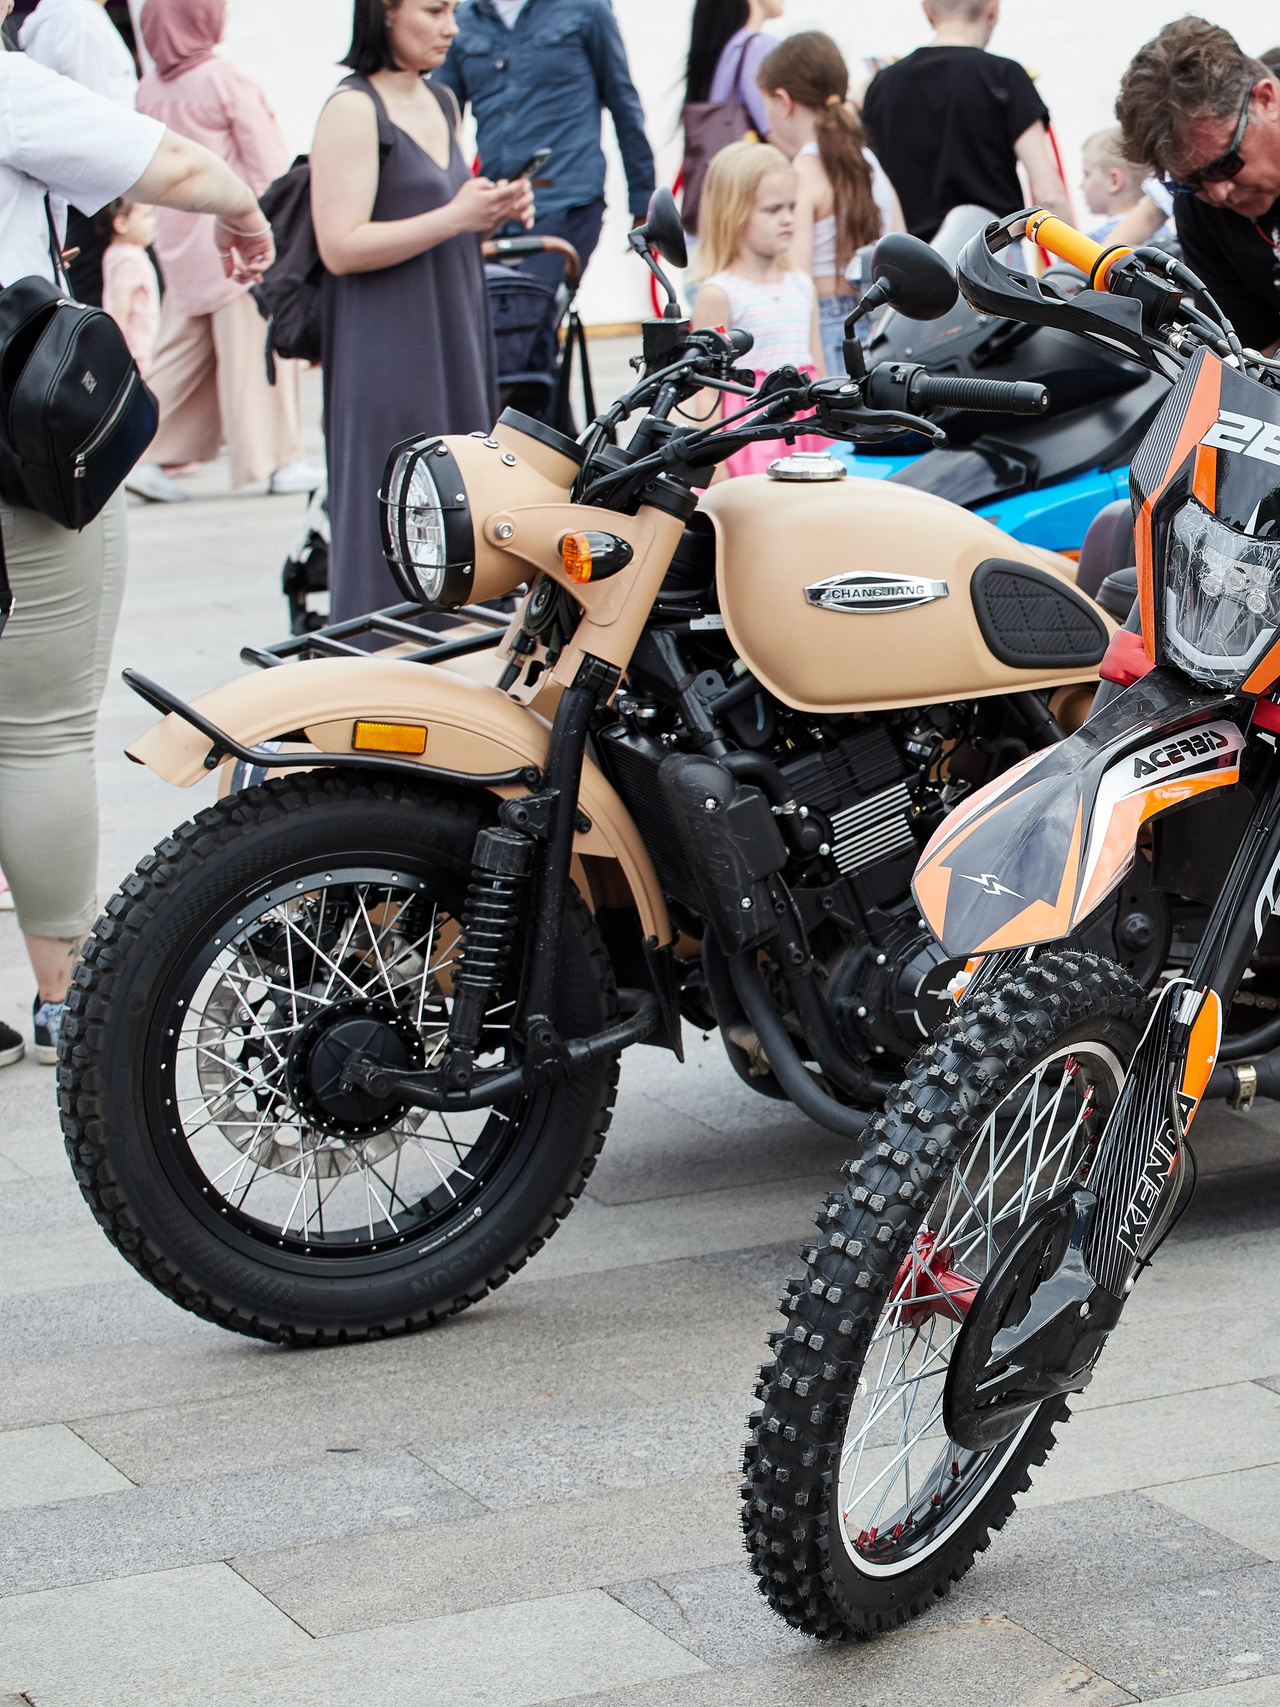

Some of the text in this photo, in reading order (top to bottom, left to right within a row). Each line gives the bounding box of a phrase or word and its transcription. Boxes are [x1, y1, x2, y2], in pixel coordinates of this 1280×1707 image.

[831, 585, 924, 599] CHANGJIANG
[1133, 729, 1229, 779] ACERBIS
[1115, 1090, 1199, 1257] KENDA
